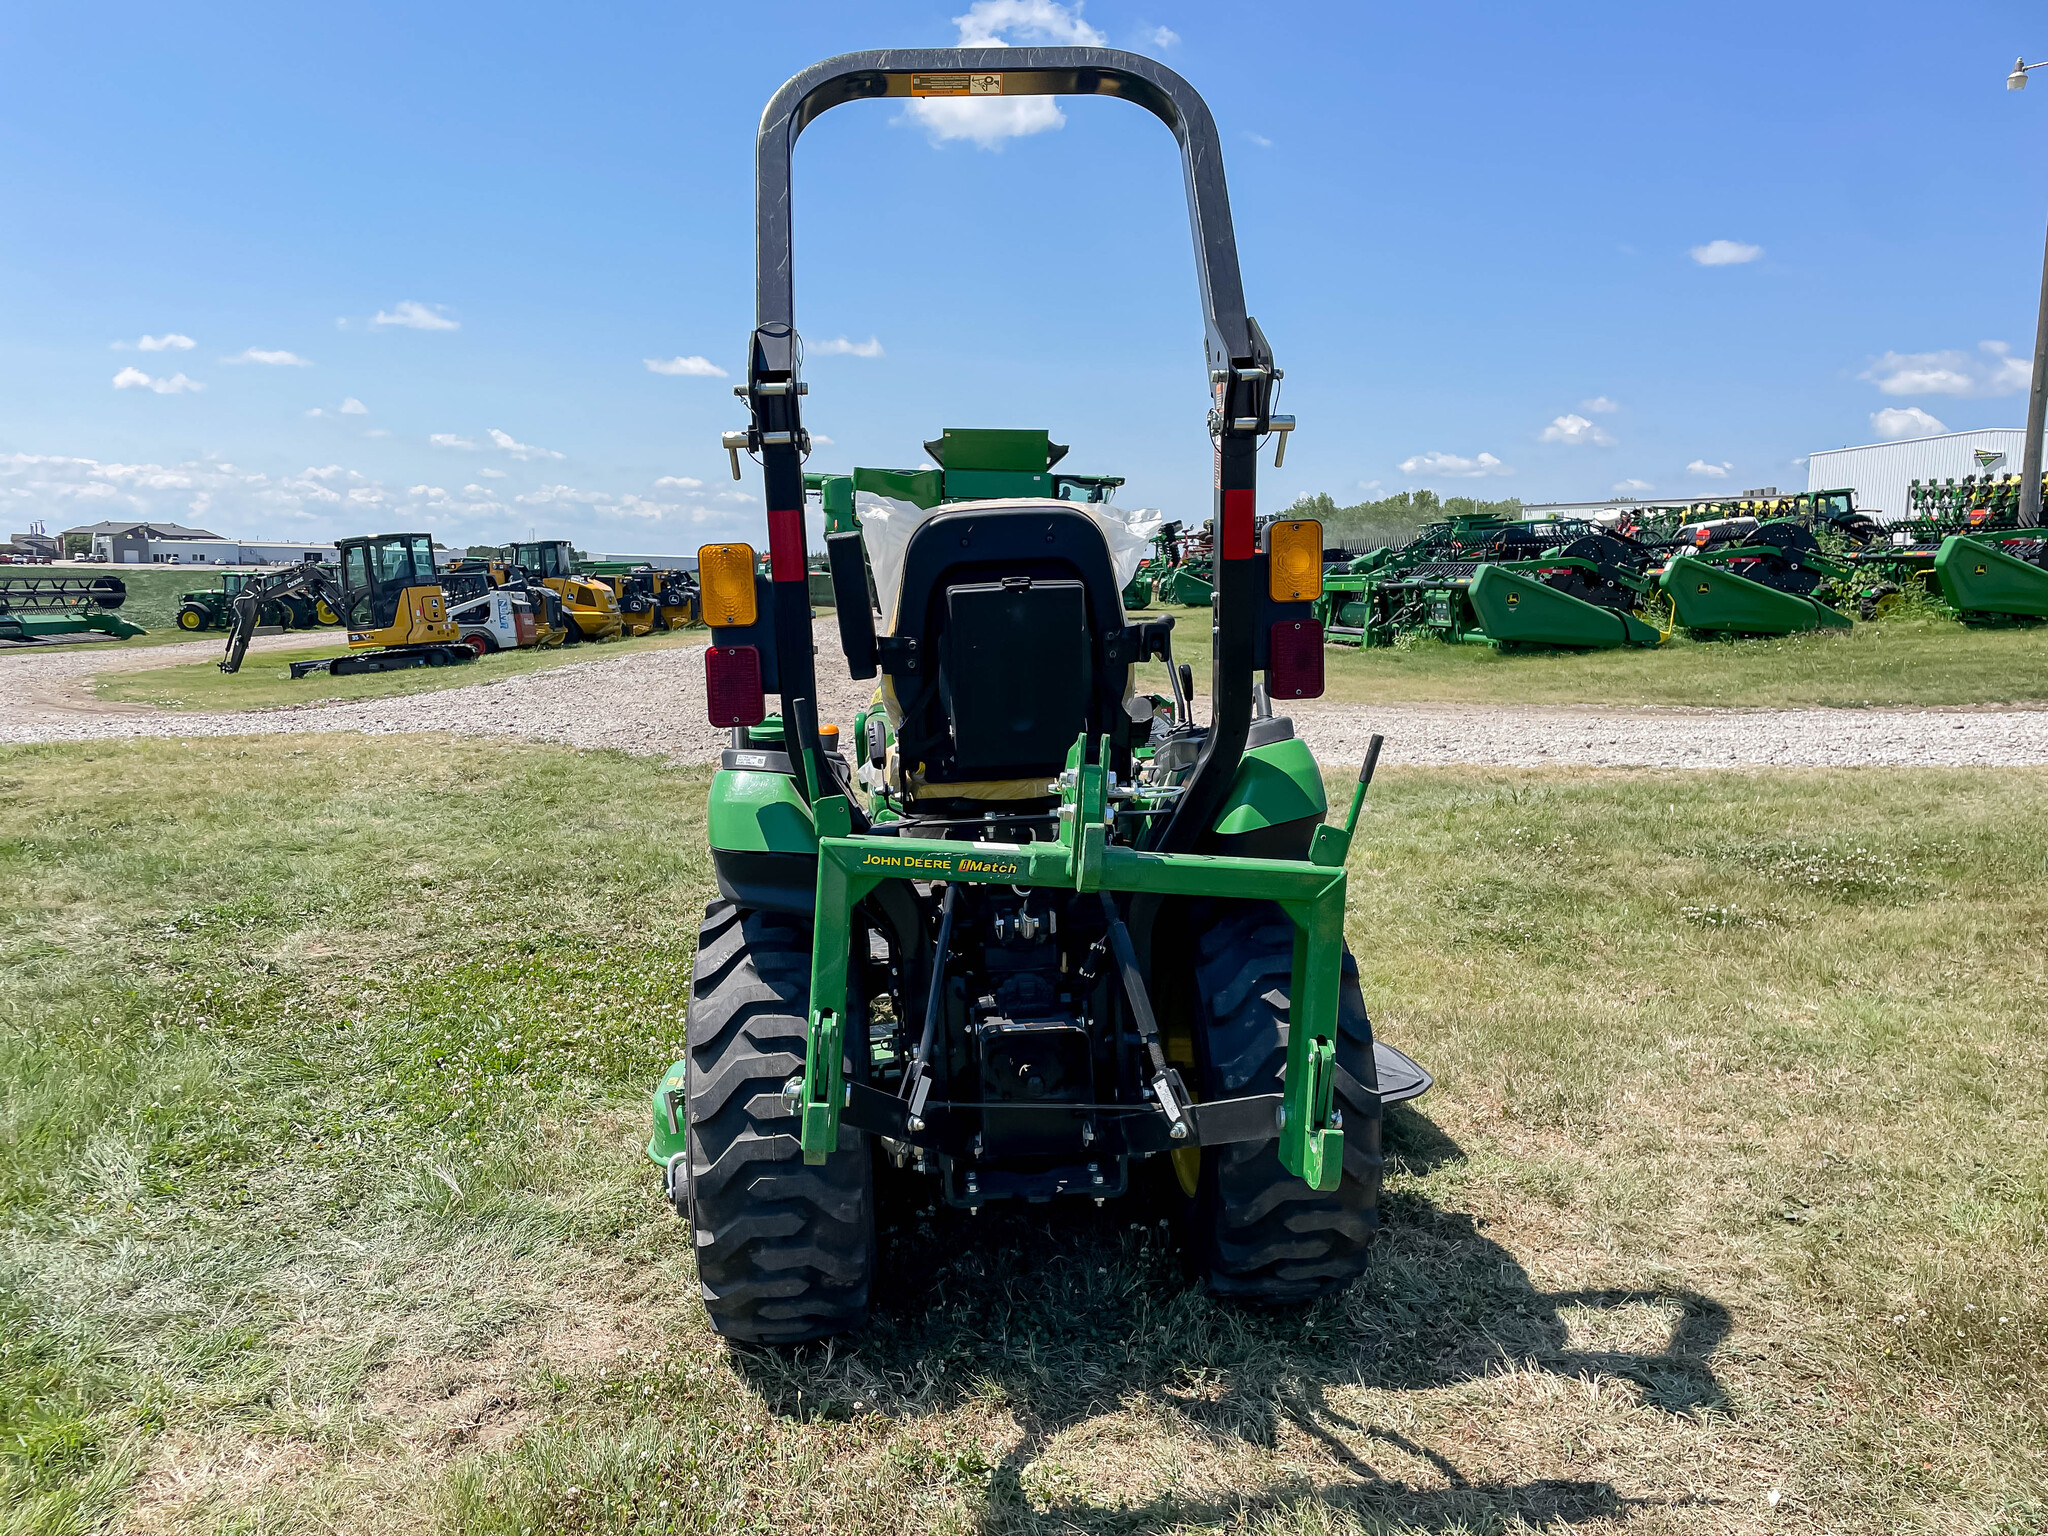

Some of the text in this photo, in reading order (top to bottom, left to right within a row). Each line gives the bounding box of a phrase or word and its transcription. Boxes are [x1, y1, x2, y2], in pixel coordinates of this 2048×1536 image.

[287, 576, 304, 588] DEERE
[862, 854, 1017, 874] JOHN DEERE iMatch
